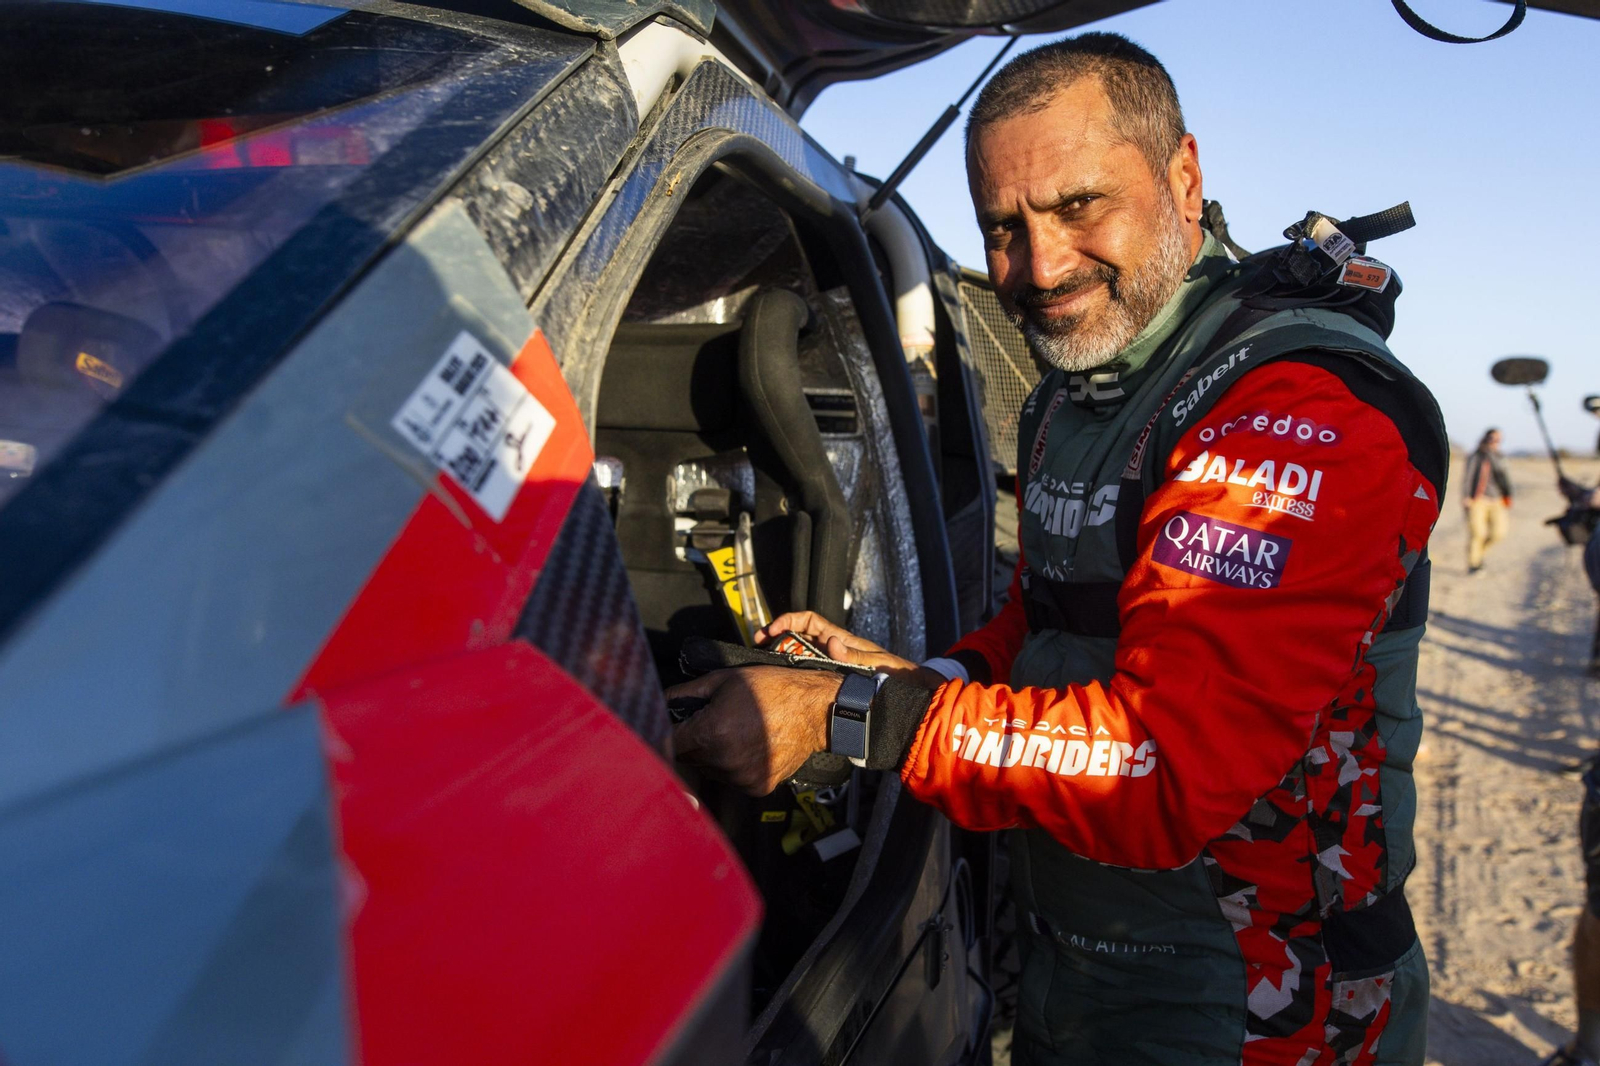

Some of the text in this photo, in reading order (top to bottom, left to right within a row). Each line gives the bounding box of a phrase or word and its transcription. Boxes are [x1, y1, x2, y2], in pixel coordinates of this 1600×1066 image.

[1324, 233, 1342, 251] FIA
[1172, 343, 1252, 428] Sabelt
[1174, 450, 1323, 502] BALADI
[1252, 490, 1315, 518] express
[1164, 515, 1280, 571] QATAR
[1179, 549, 1274, 589] AIRWAYS
